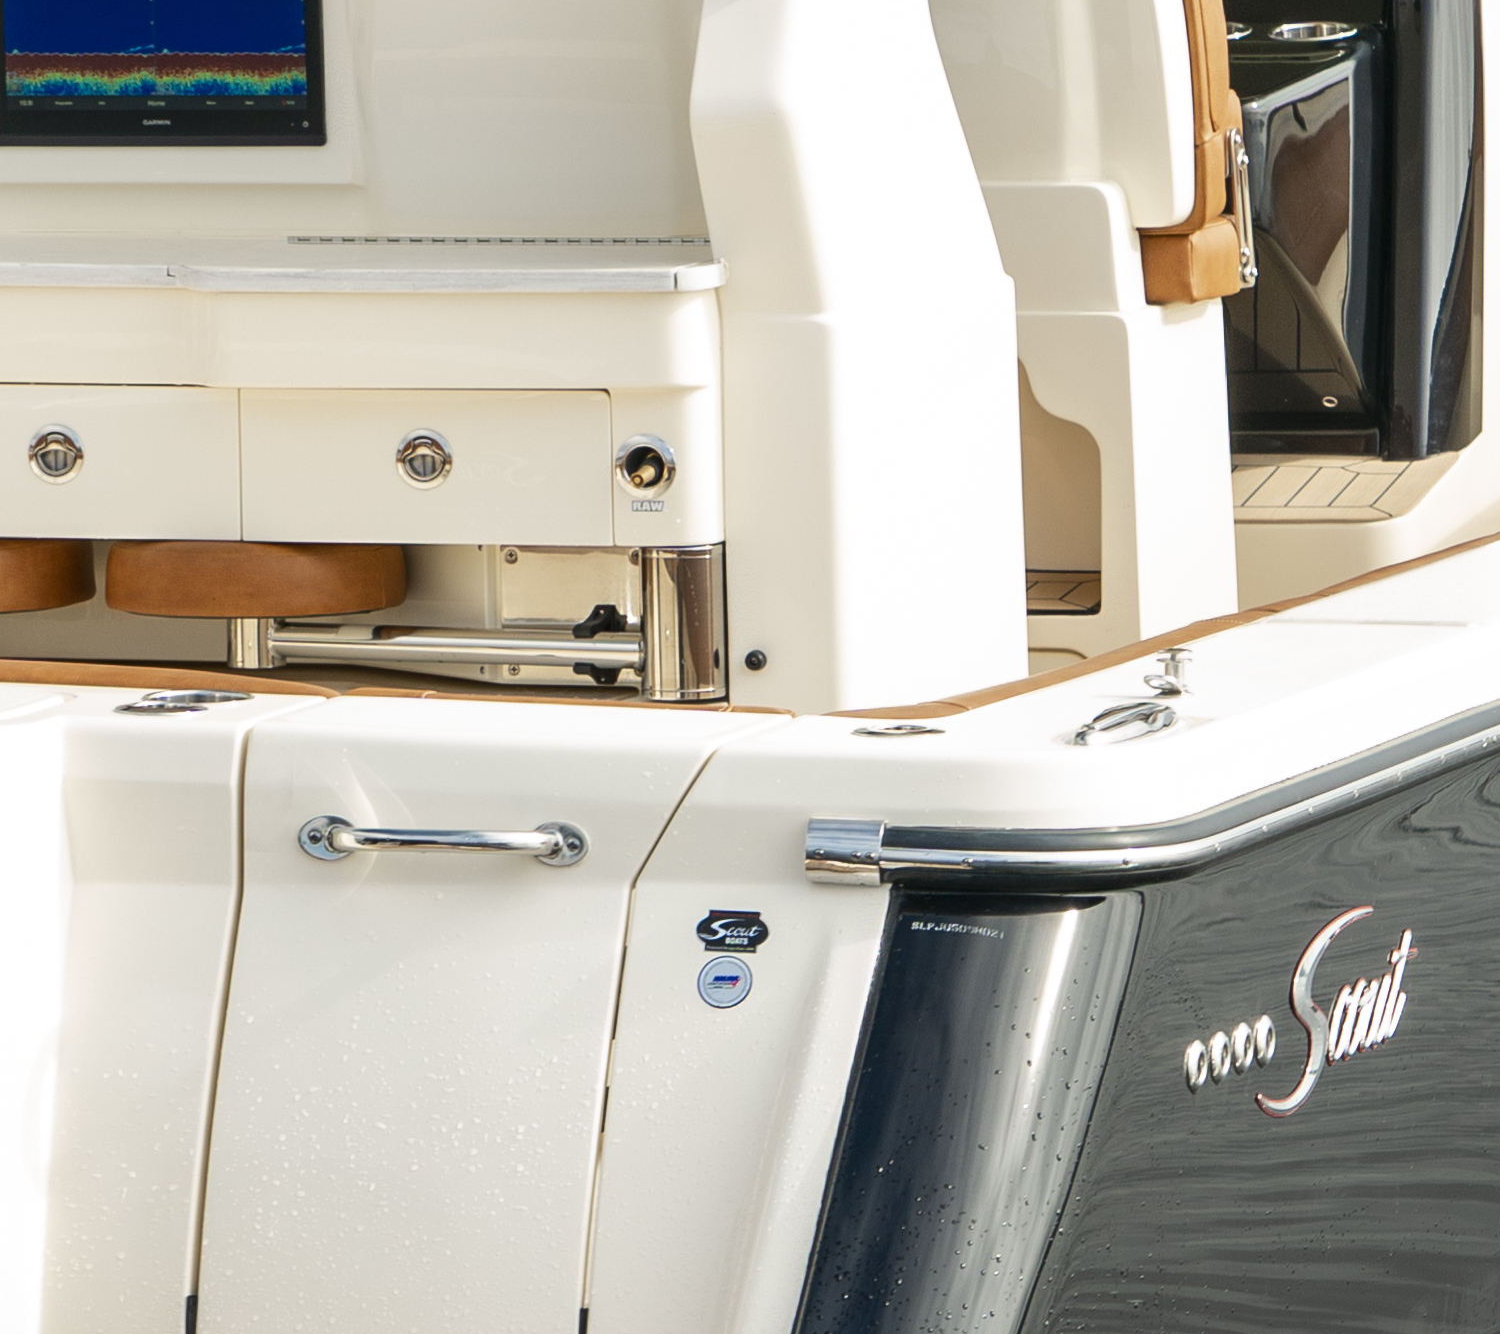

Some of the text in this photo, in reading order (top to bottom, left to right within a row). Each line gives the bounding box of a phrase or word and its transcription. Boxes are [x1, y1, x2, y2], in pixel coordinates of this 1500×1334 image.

[632, 500, 664, 512] RAW
[699, 918, 763, 940] Scout
[1256, 905, 1419, 1118] Scout
